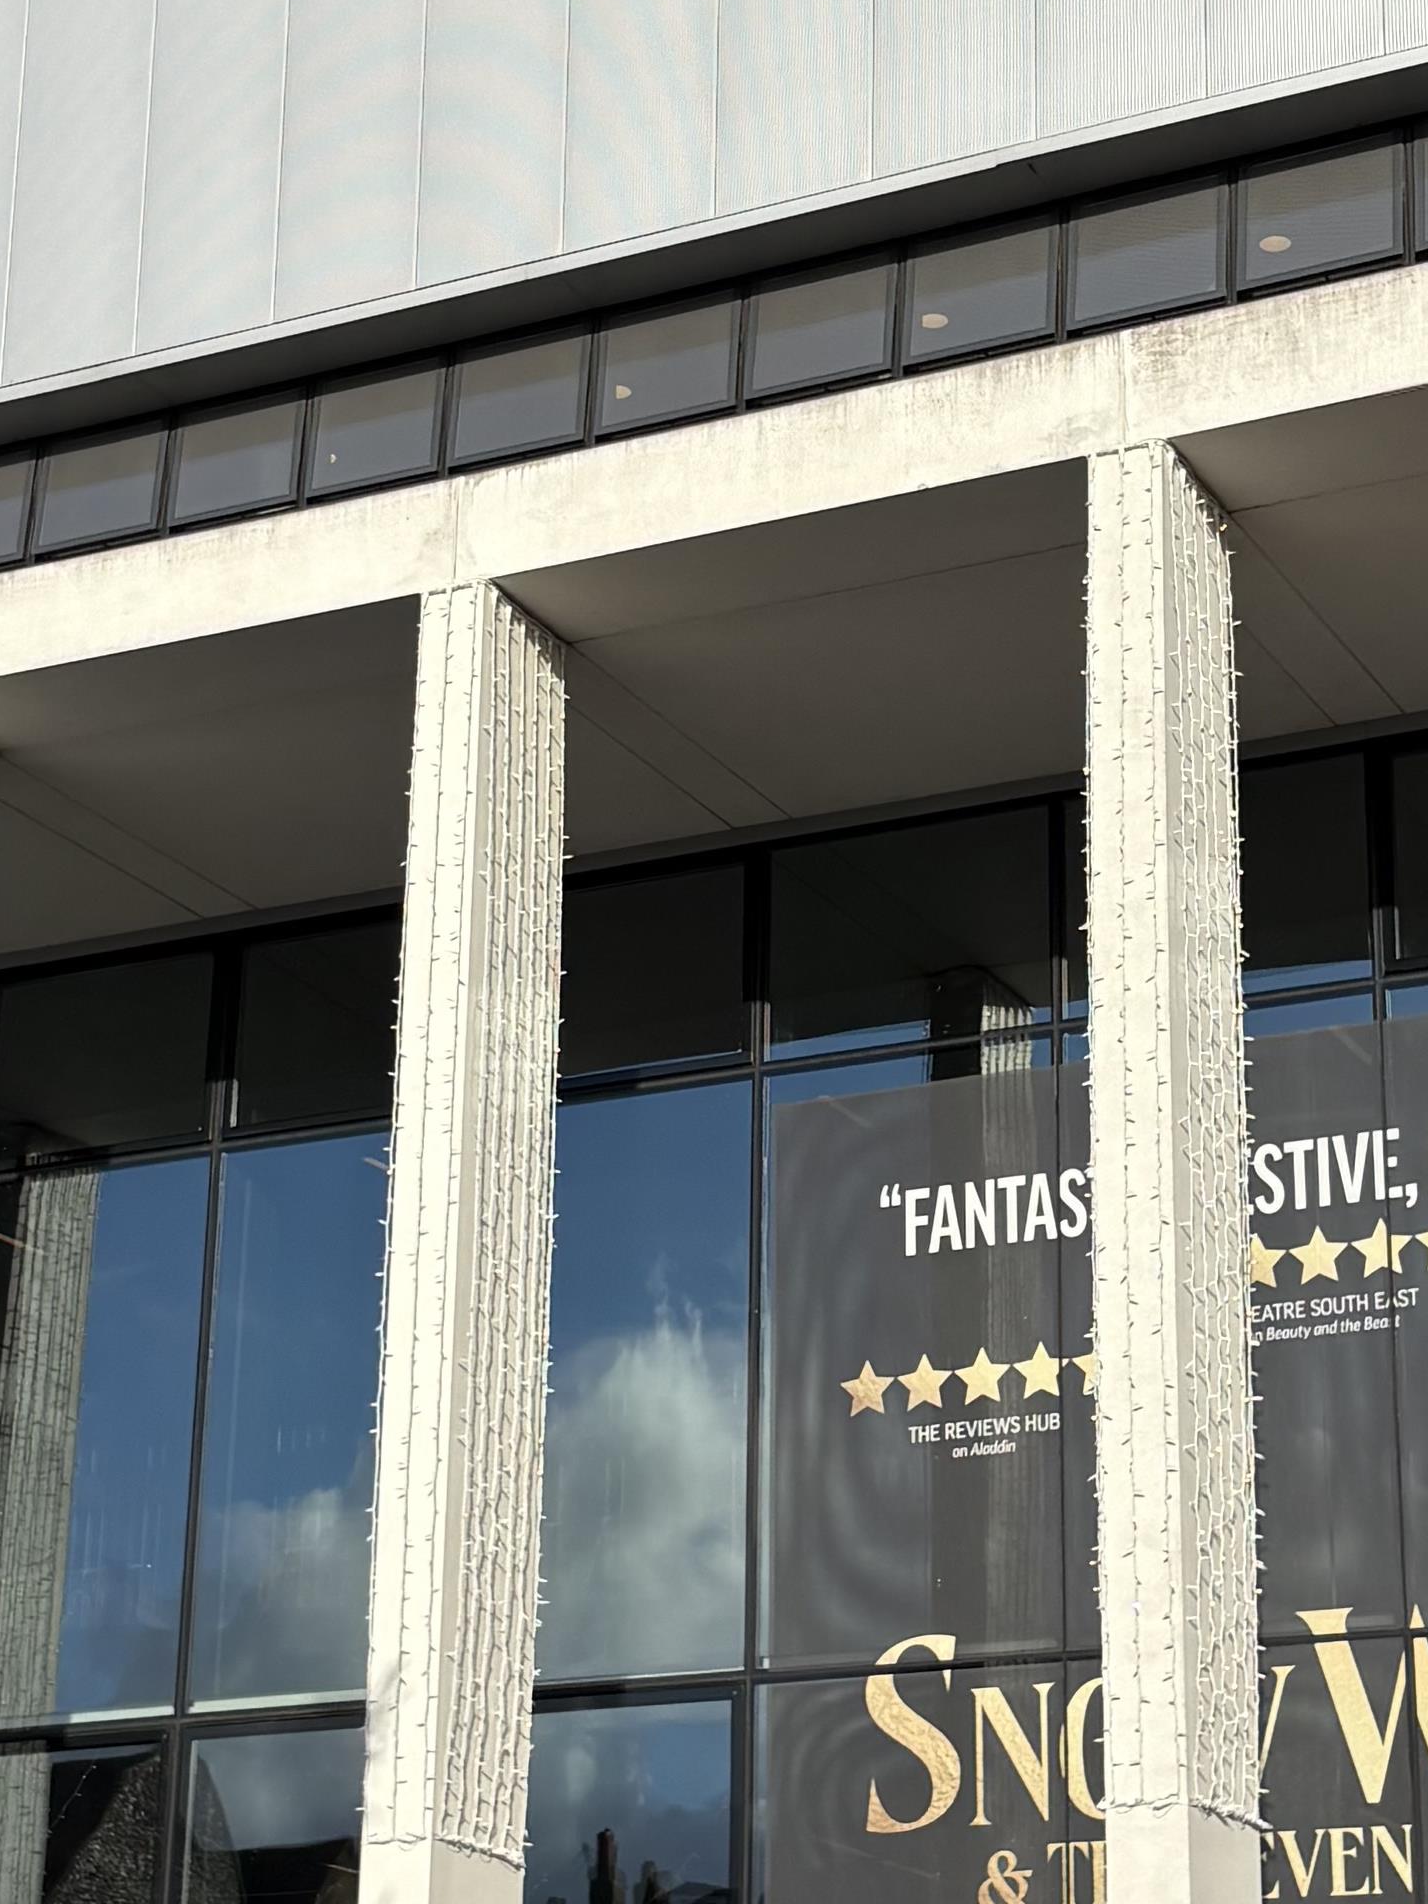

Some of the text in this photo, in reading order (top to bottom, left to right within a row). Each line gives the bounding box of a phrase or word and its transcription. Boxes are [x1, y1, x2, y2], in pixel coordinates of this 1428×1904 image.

[1310, 1293, 1370, 1317] SOUTH
[1374, 1287, 1420, 1310] EAST
[1265, 1324, 1312, 1342] Beauty
[1314, 1322, 1338, 1336] and
[1340, 1319, 1361, 1334] the
[1363, 1314, 1401, 1331] Beat
[908, 1412, 1061, 1444] THE REVIEWS HUB
[952, 1439, 1017, 1458] on Aladdin
